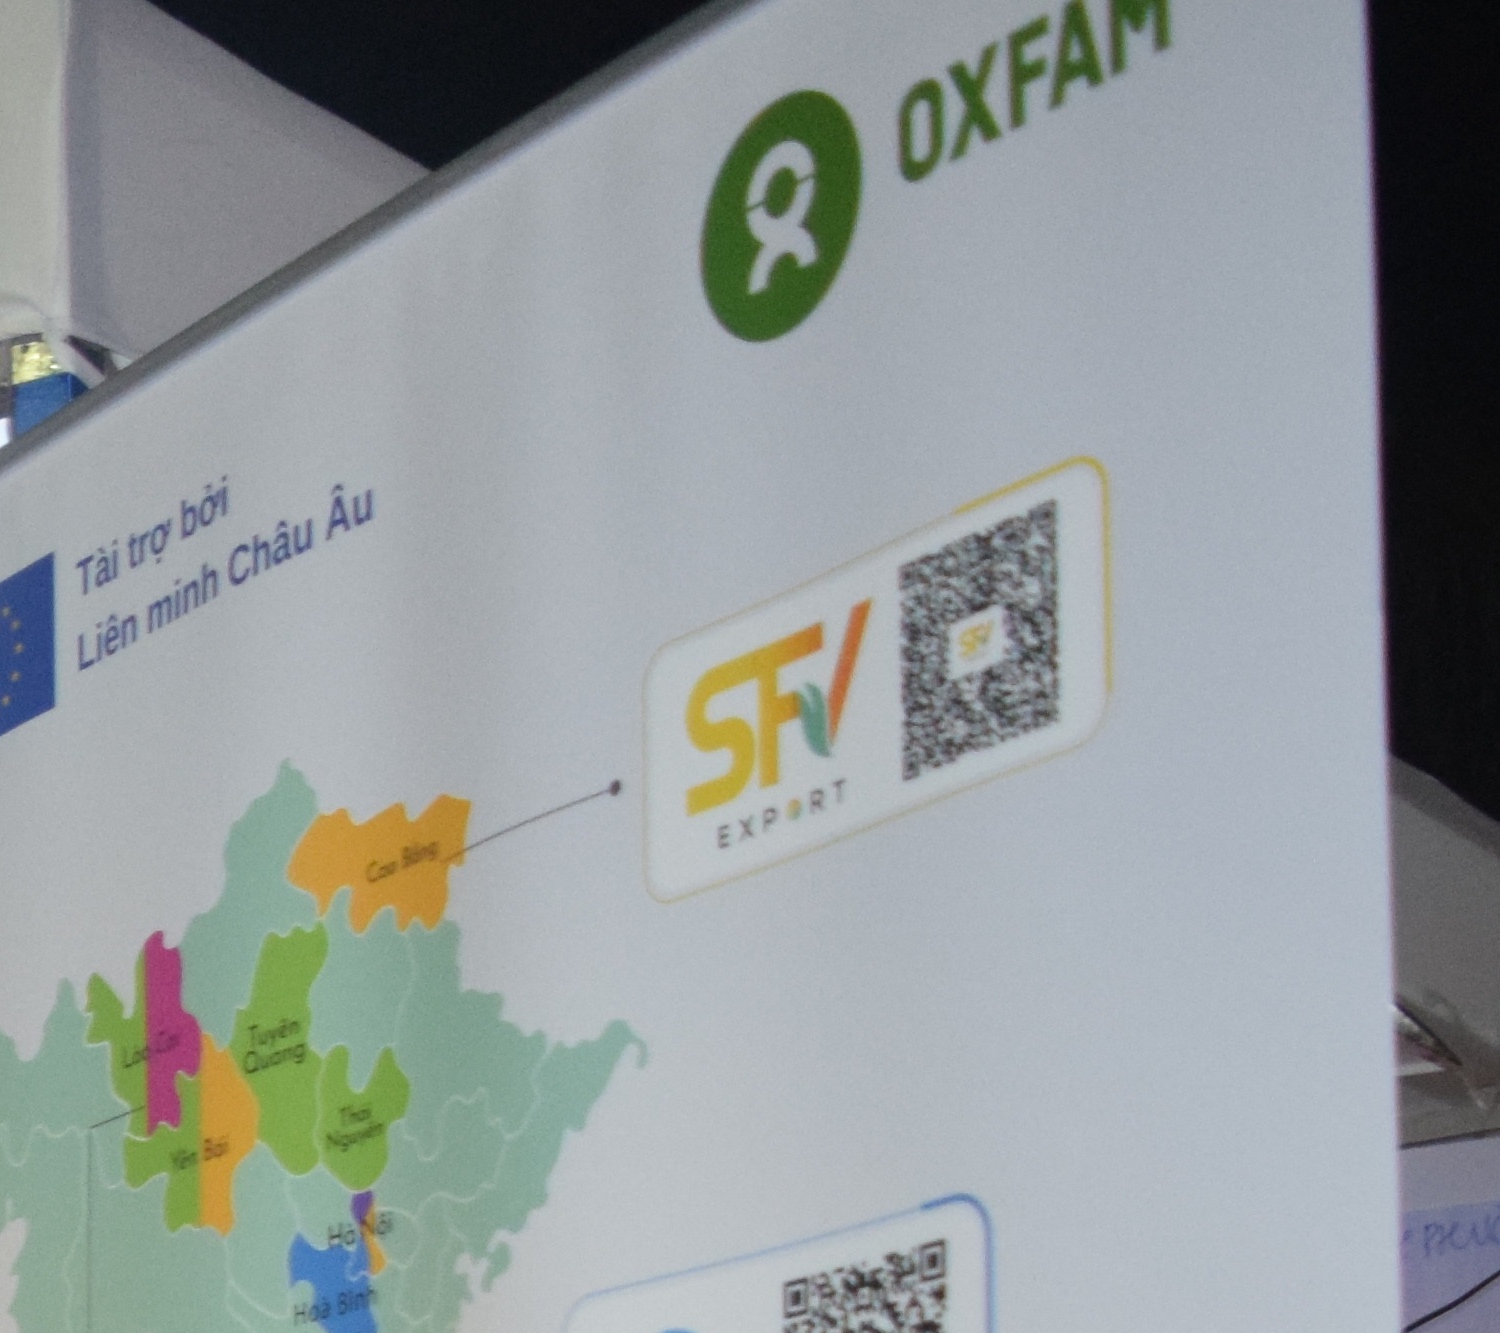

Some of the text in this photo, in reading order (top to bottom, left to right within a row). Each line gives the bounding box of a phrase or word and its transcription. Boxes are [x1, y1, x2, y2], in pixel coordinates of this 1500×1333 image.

[899, 0, 1173, 182] OXFAM
[76, 474, 231, 595] Tài trợ bởi
[77, 483, 374, 670] Liên minh Châu Âu
[686, 597, 873, 817] SFV
[716, 778, 847, 849] EXPORT
